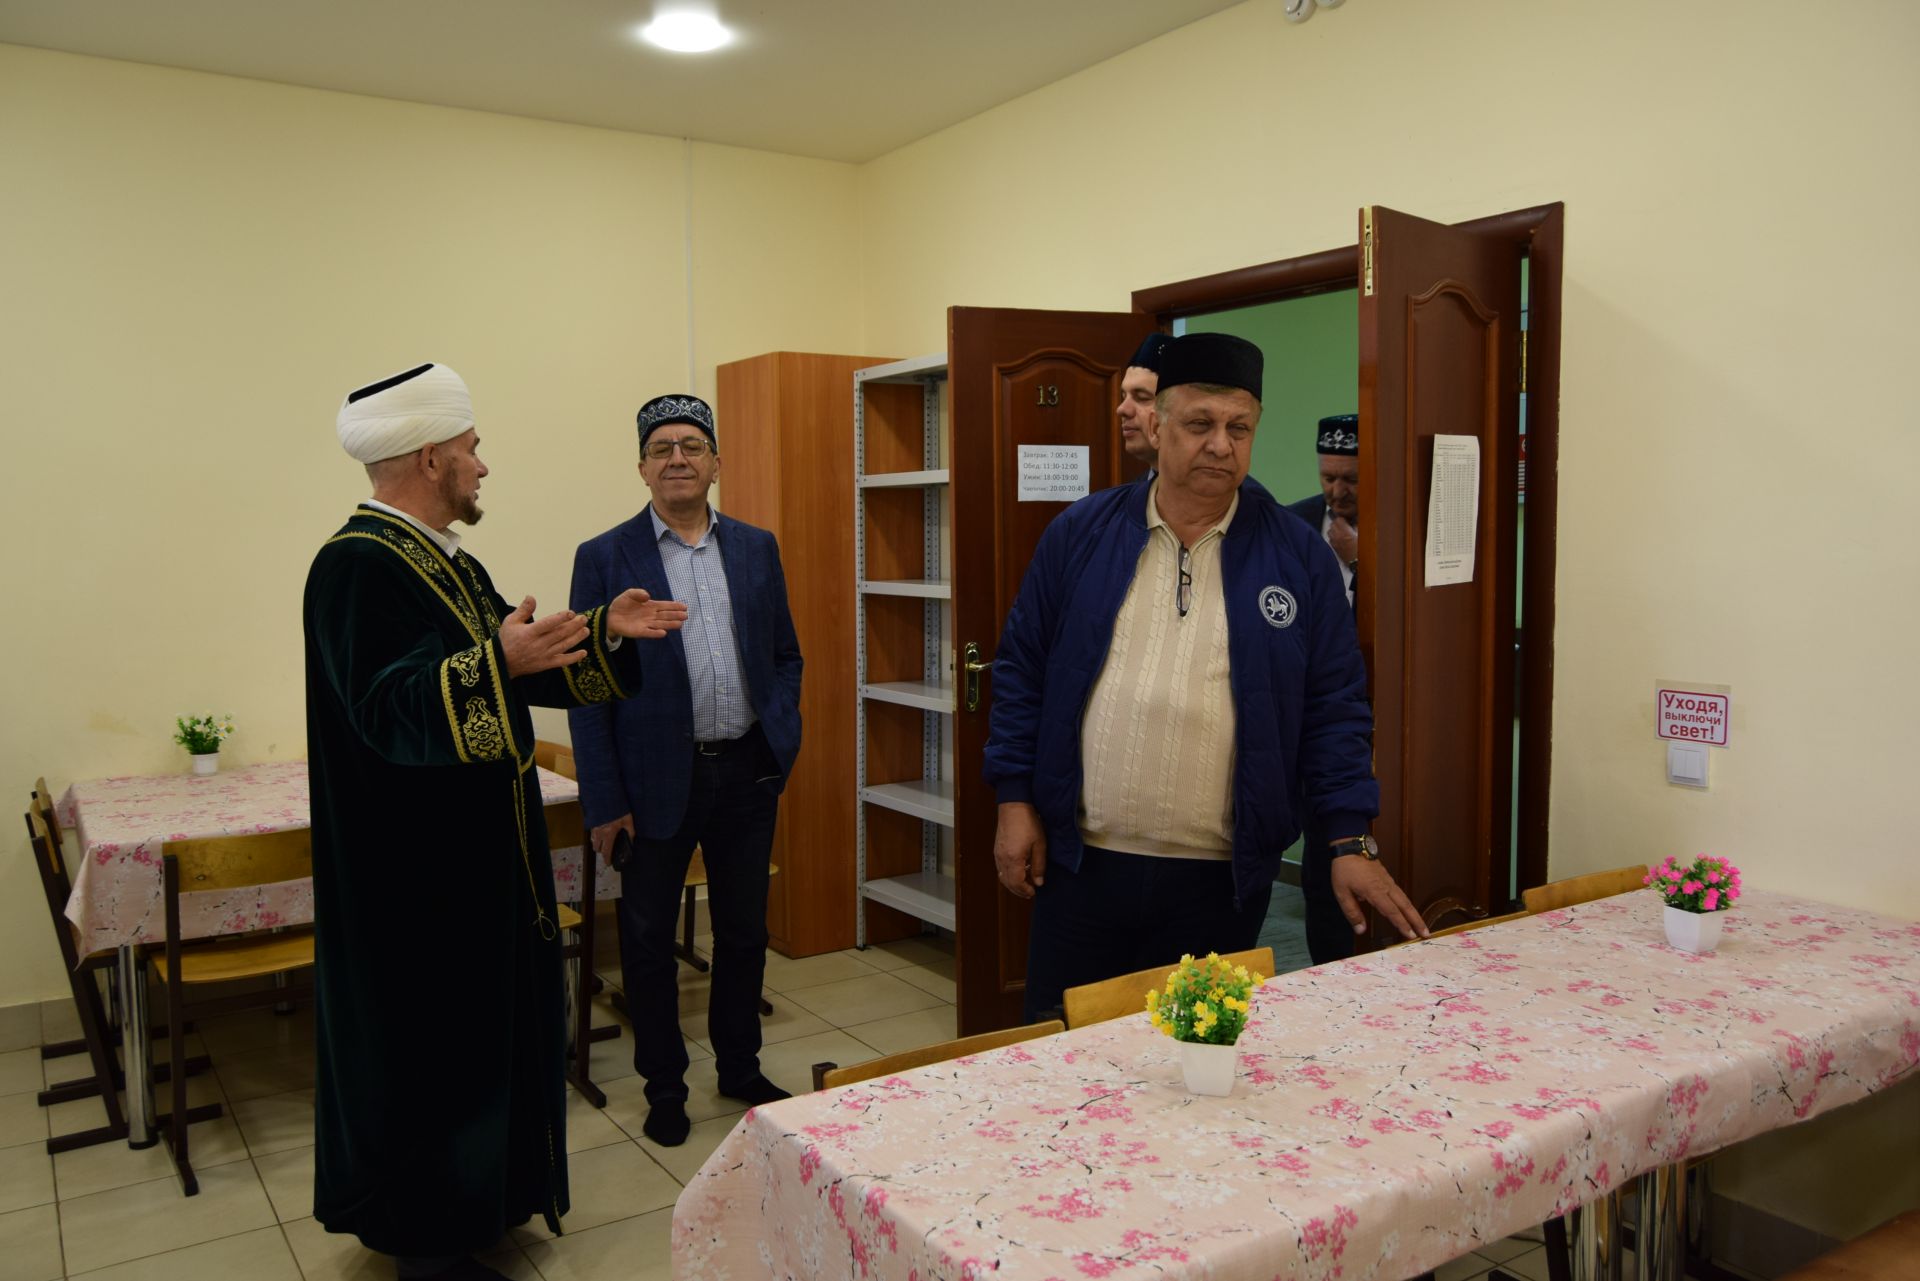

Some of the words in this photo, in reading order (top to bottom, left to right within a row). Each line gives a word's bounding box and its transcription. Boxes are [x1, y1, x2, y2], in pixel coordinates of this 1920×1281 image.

[1036, 384, 1059, 406] 13
[1663, 693, 1723, 717] Уходя,
[1665, 711, 1721, 726] выключи
[1670, 724, 1714, 740] свет!
